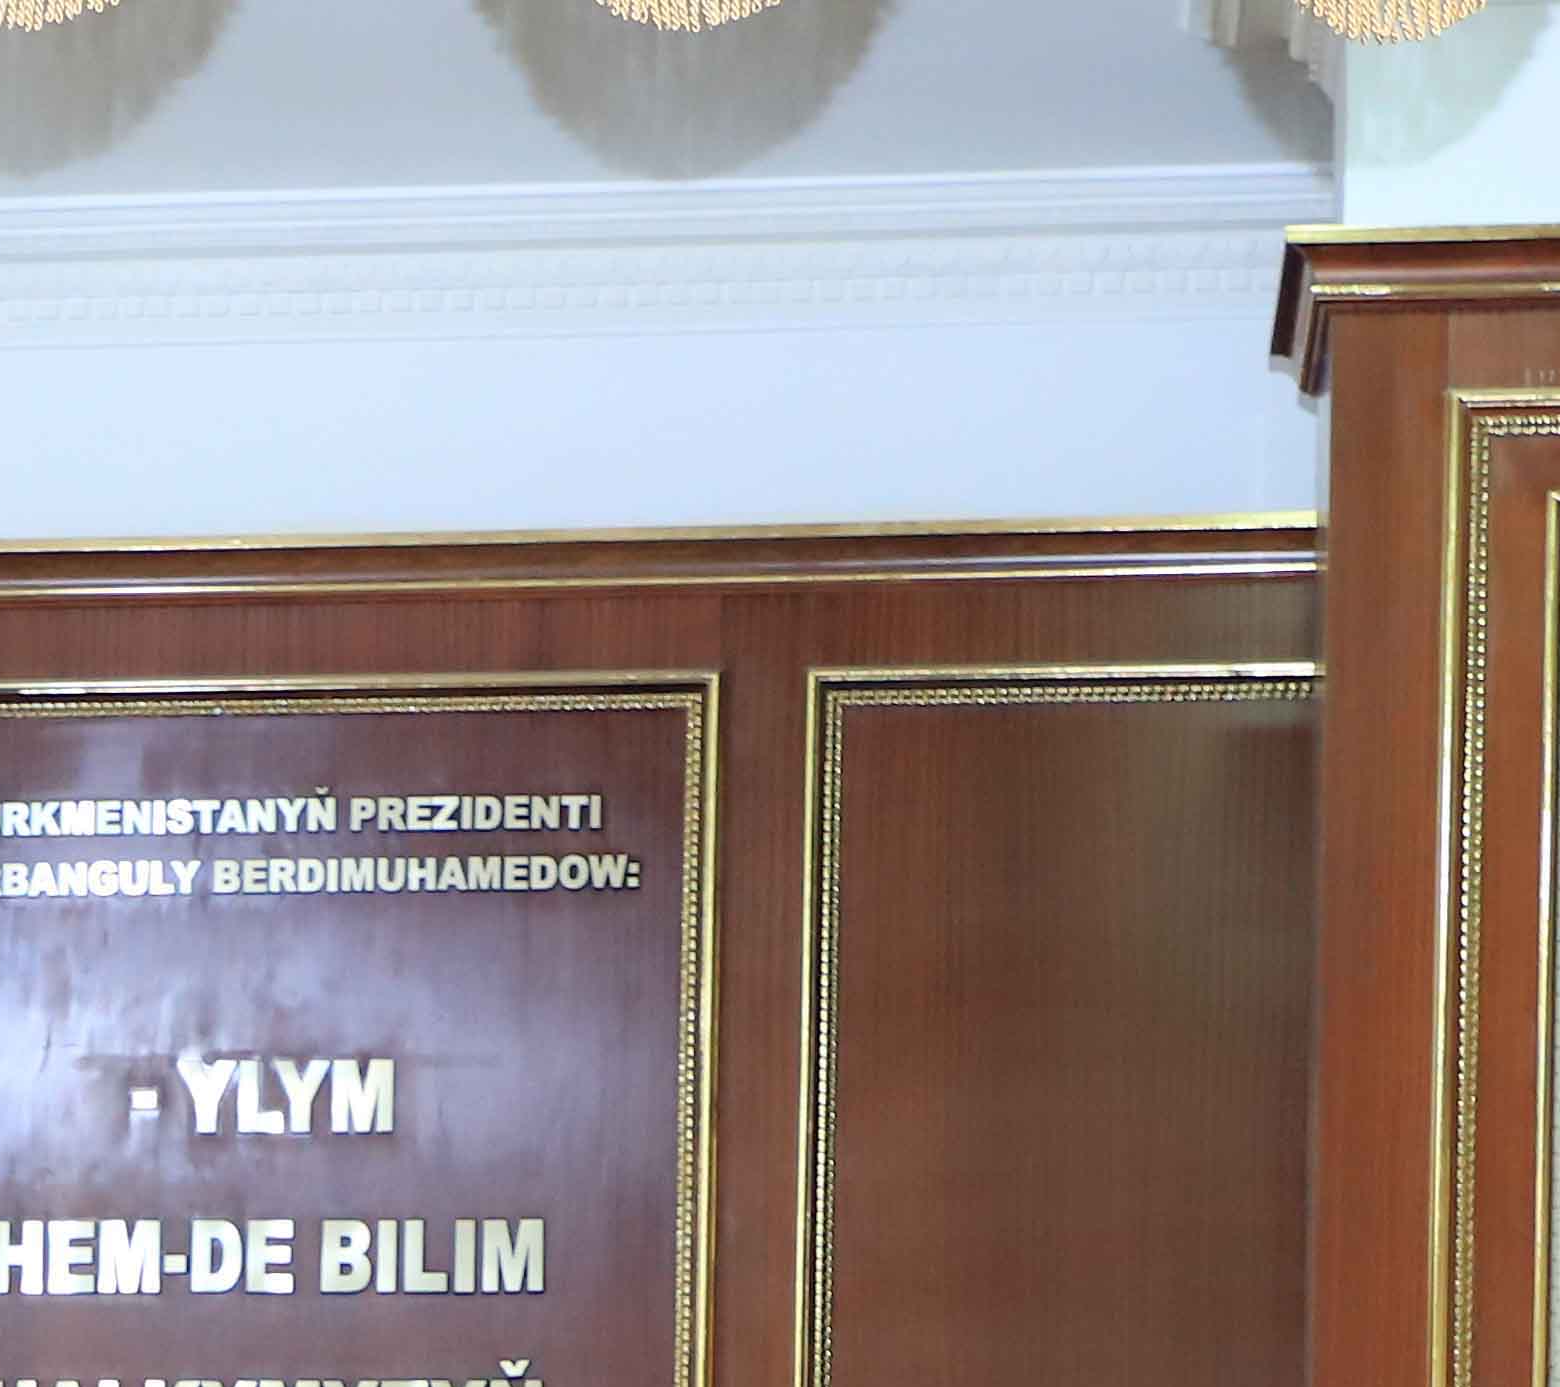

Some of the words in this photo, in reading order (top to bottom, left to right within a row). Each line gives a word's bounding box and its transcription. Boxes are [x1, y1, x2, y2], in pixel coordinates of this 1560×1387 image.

[348, 794, 603, 834] PREZIDENTI
[212, 853, 642, 896] BERDIMUHAMEDOW:
[177, 1057, 396, 1135] YLYM
[318, 1217, 547, 1296] BILIM
